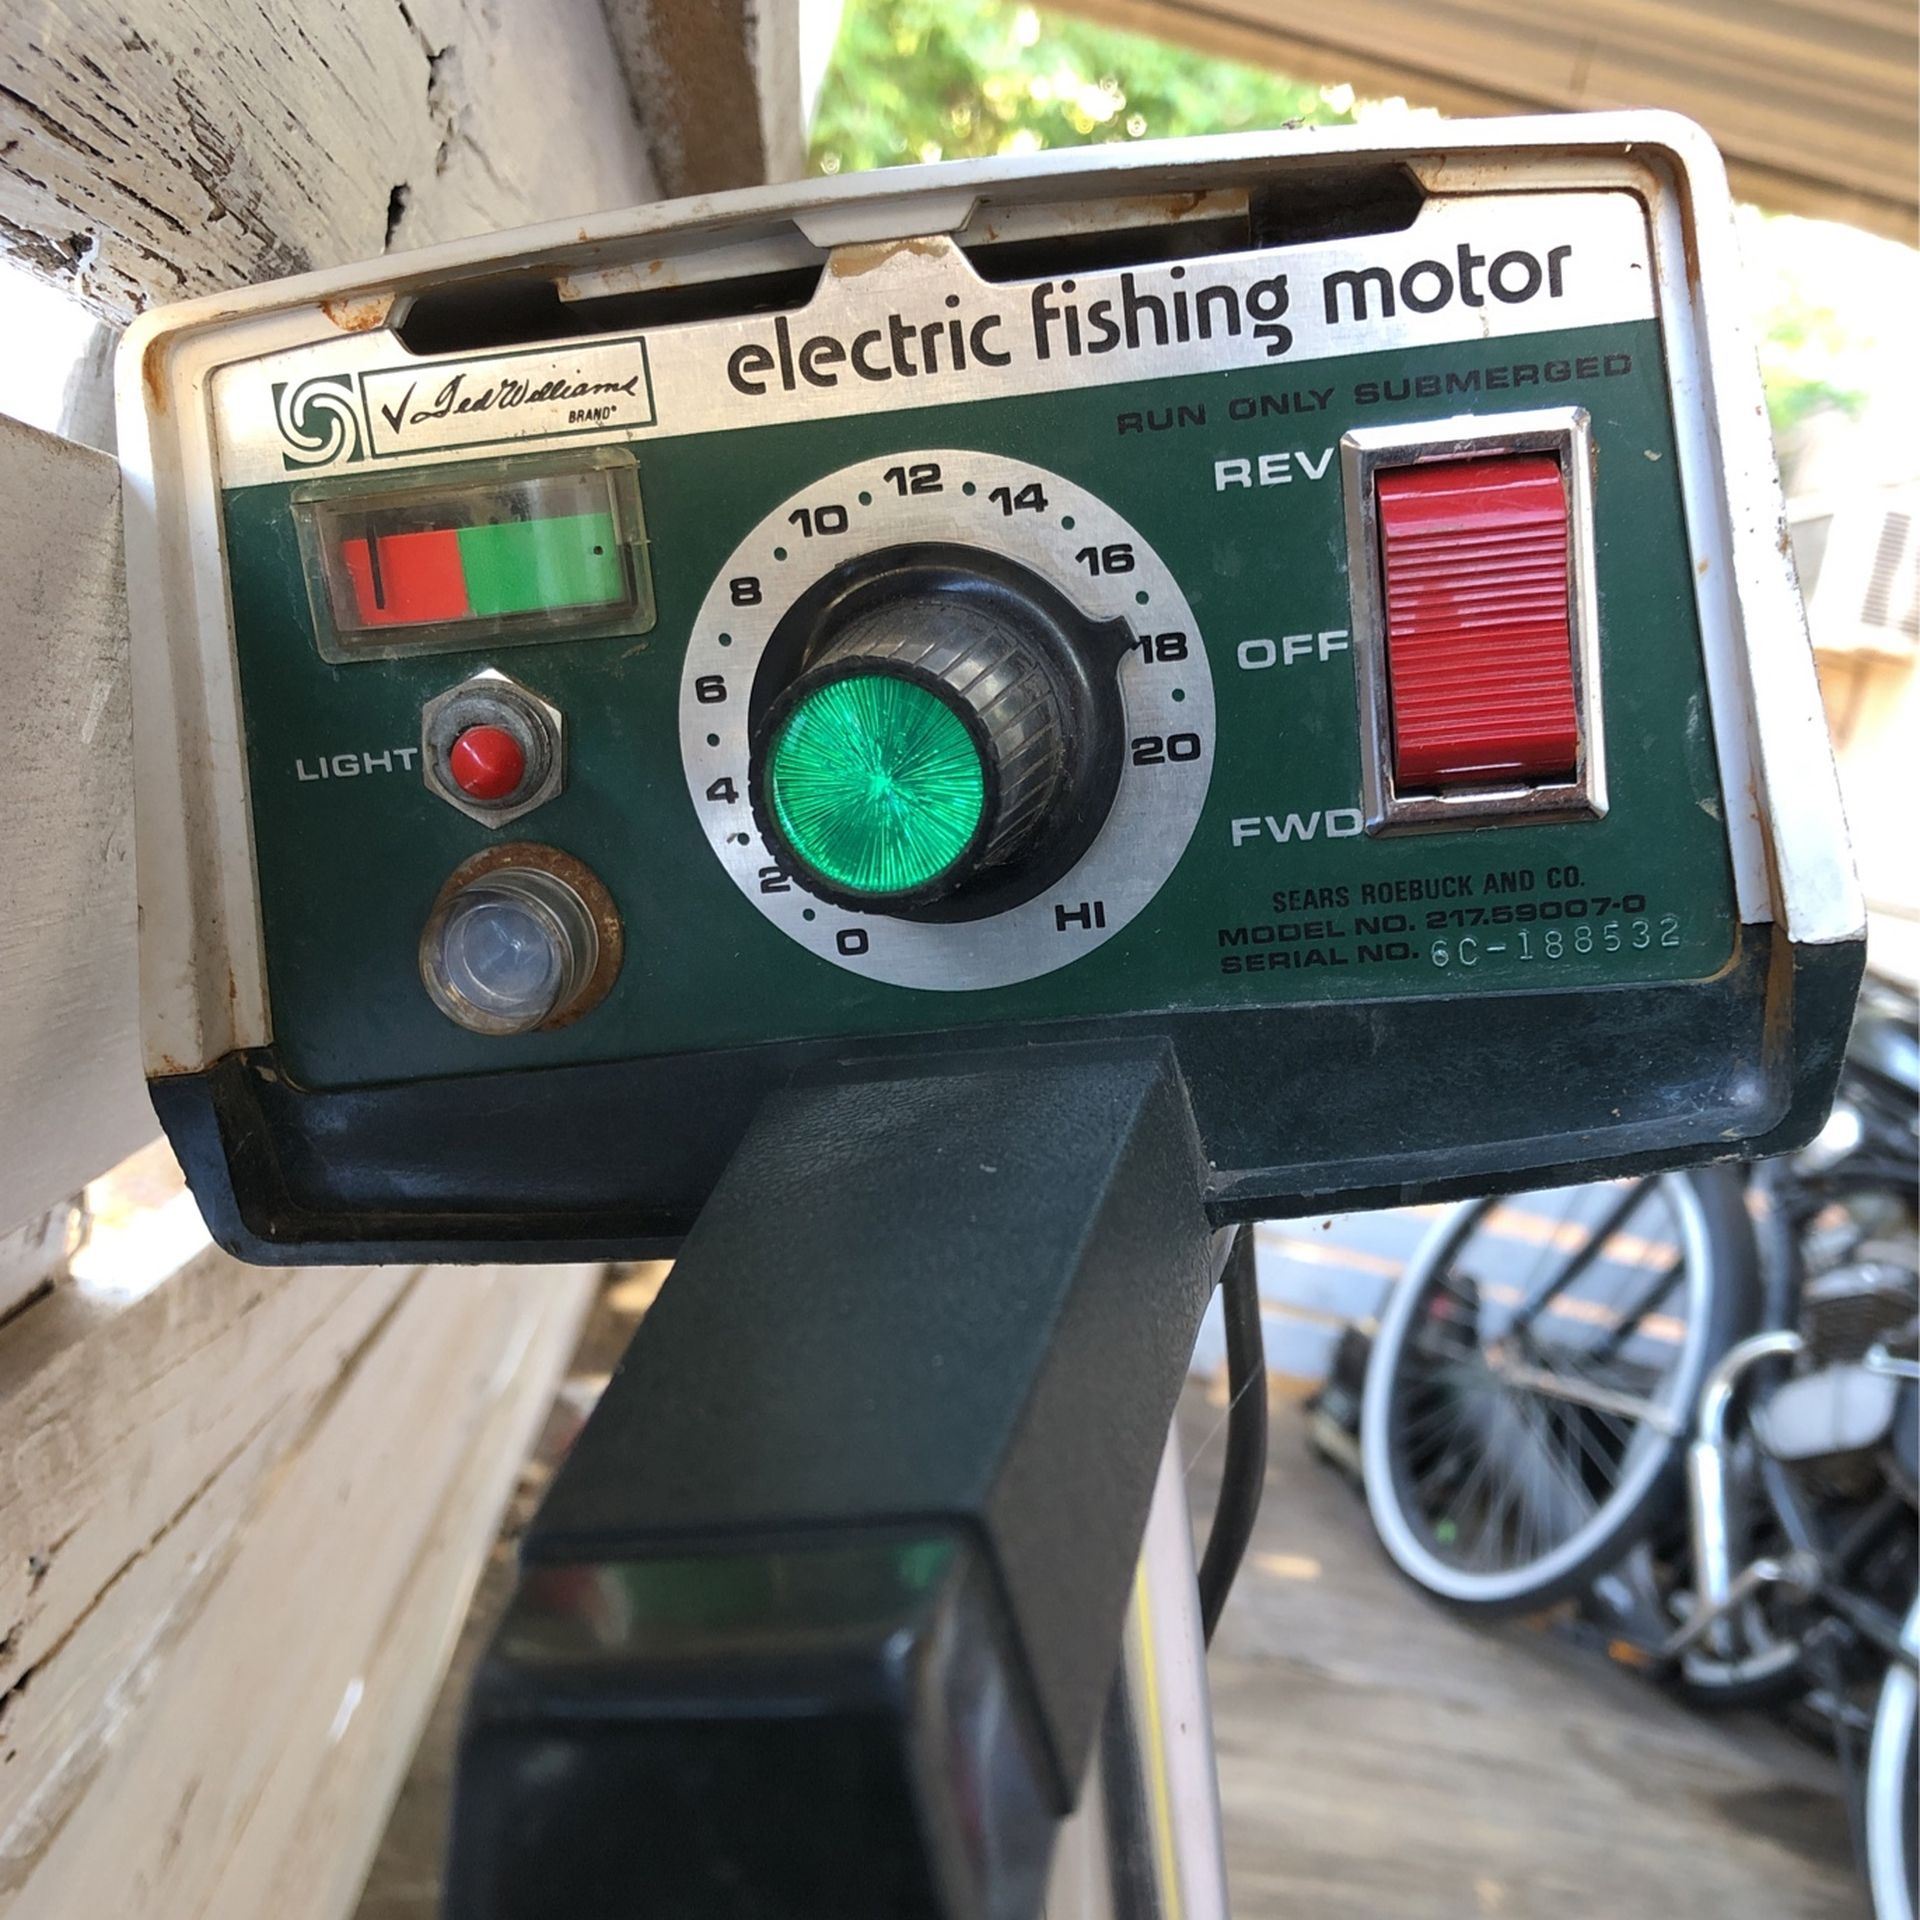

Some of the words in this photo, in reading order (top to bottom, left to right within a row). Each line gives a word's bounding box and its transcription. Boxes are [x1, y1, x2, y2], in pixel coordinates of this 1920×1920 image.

[726, 294, 1012, 395] electric
[1031, 266, 1291, 357] fishing
[1323, 242, 1573, 325] motor
[1116, 403, 1207, 435] RUN
[1228, 386, 1336, 420] ONLY
[1353, 352, 1633, 406] SUBMERGED
[882, 463, 944, 498] 12
[1212, 447, 1336, 492] REV
[987, 482, 1050, 517] 14
[787, 504, 850, 538] 10
[1073, 543, 1136, 577] 16
[729, 576, 763, 608] 8
[1134, 631, 1189, 665] 18
[1236, 629, 1350, 671] OFF
[693, 674, 729, 706] 6
[295, 747, 418, 782] LIGHT
[1130, 732, 1203, 767] 20
[705, 776, 740, 806] 4
[1230, 807, 1365, 848] FWD
[758, 866, 791, 894] 2
[1271, 883, 1350, 914] SEARS
[1360, 874, 1473, 905] ROEBUCK
[1483, 867, 1536, 895] AND
[1545, 864, 1585, 889] CO.
[1053, 900, 1107, 932] HI
[1217, 919, 1346, 948] MODEL
[1354, 913, 1416, 938] NO.
[1425, 893, 1647, 931] 217.59007-0
[834, 926, 870, 958] 0
[1219, 947, 1349, 974] SERIAL
[1356, 942, 1420, 965] NO.
[1430, 914, 1683, 968] 6C-188532
